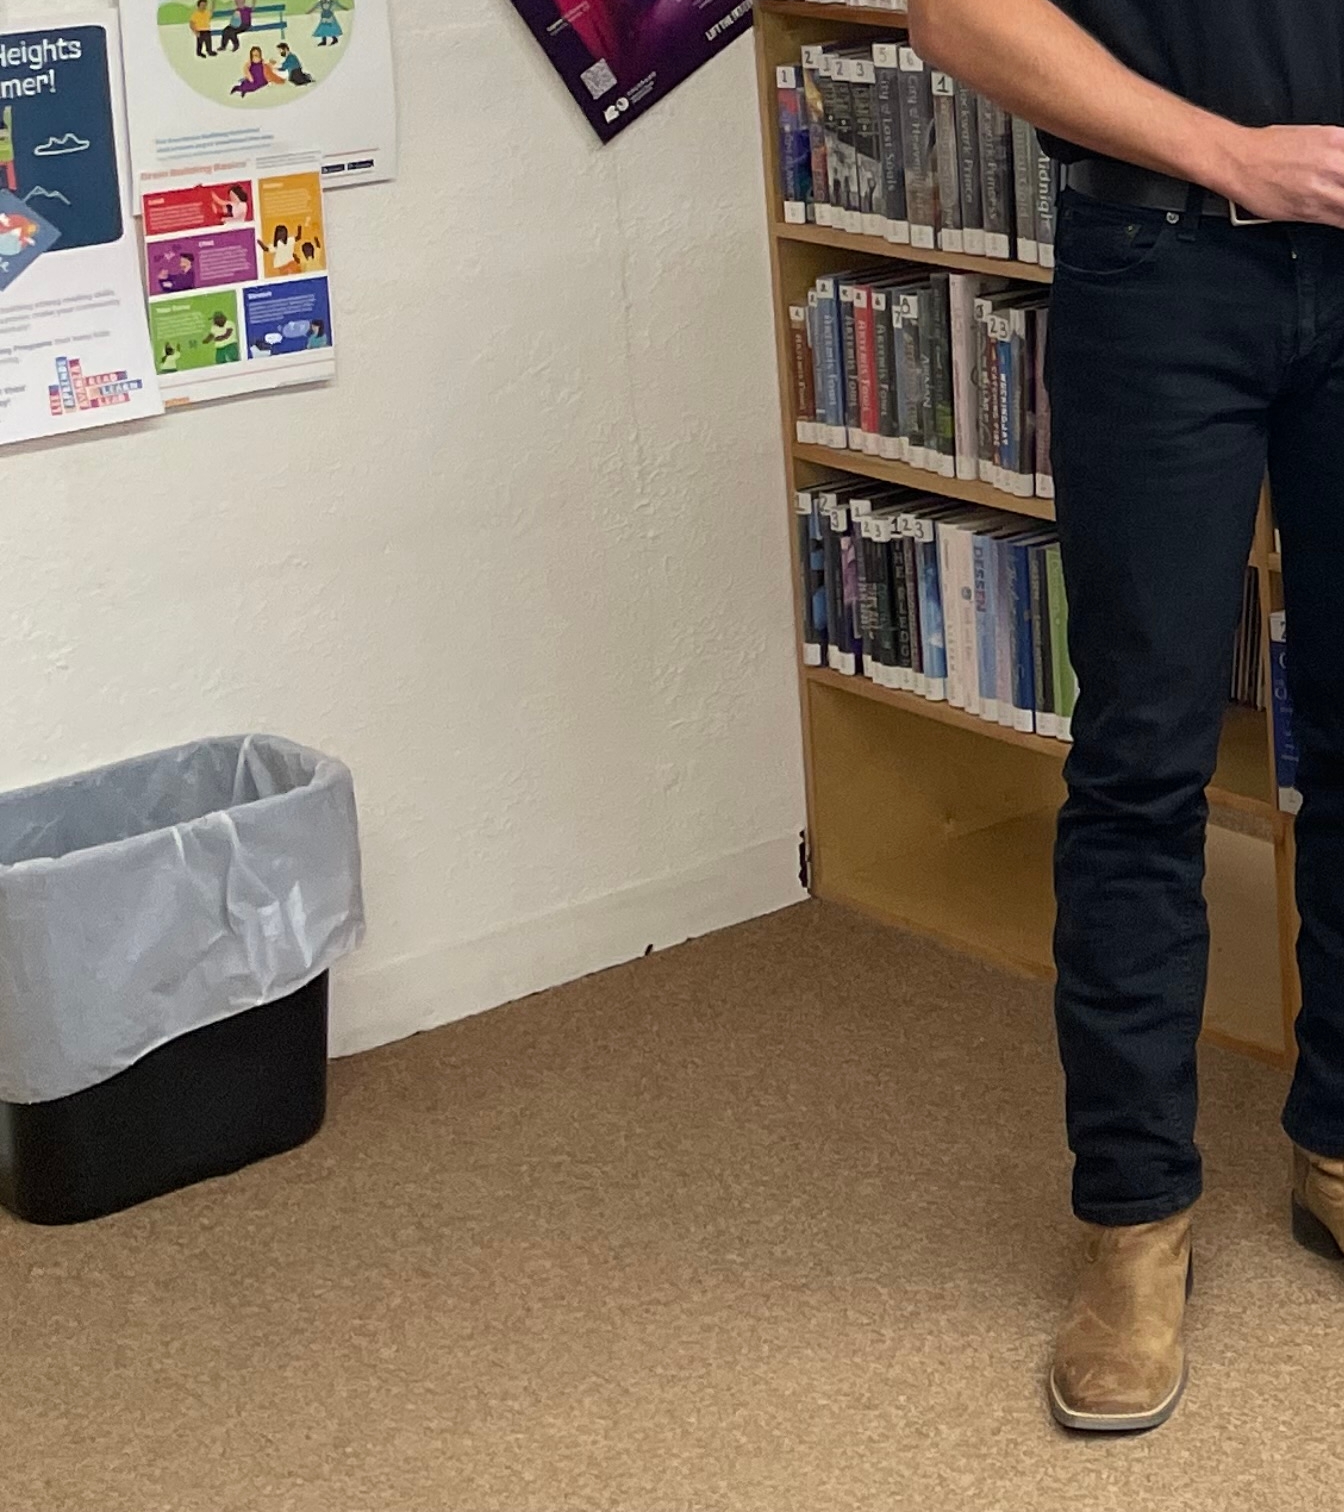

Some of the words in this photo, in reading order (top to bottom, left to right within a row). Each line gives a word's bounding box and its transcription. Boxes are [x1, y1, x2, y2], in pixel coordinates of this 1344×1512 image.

[882, 119, 896, 148] Lost
[886, 154, 898, 192] Souls
[1000, 374, 1009, 445] MOCKINGJAY
[974, 545, 987, 613] DESSEN
